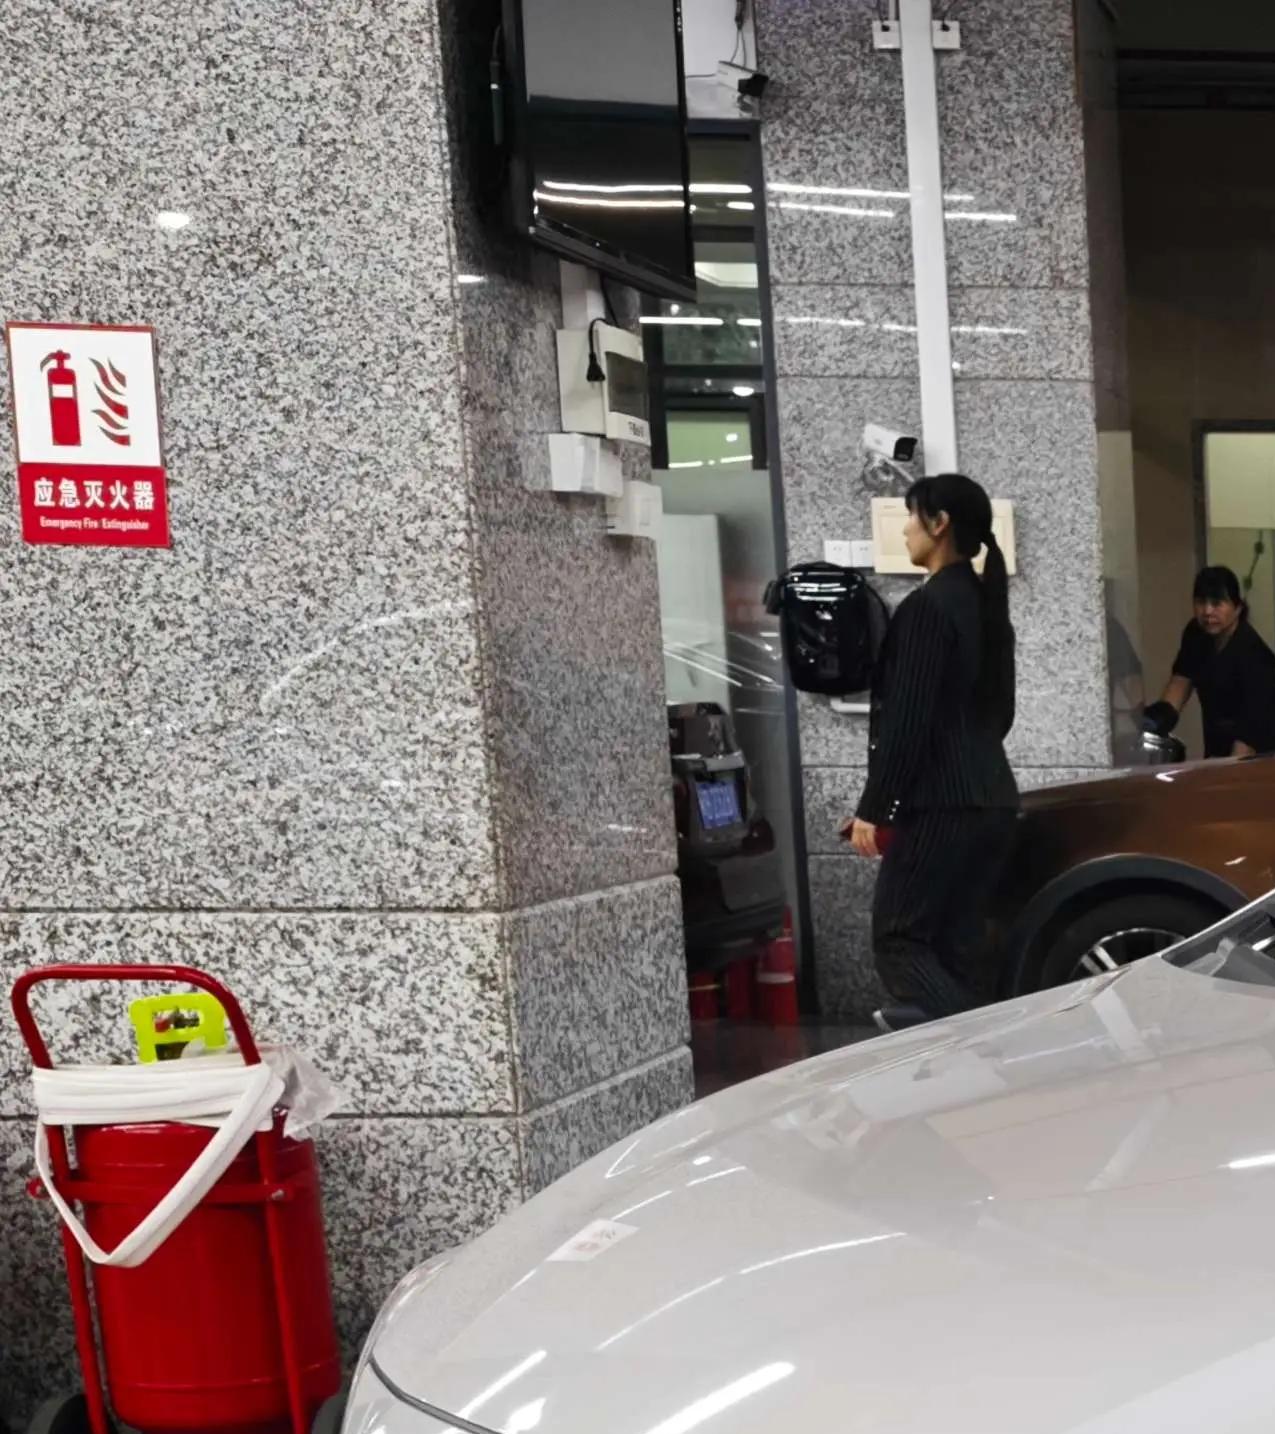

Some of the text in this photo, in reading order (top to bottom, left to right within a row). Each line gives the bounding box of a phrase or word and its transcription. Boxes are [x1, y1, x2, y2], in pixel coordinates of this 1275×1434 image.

[34, 478, 155, 511] 应急灭火器
[40, 515, 149, 531] Emergency Fire Extinguisher
